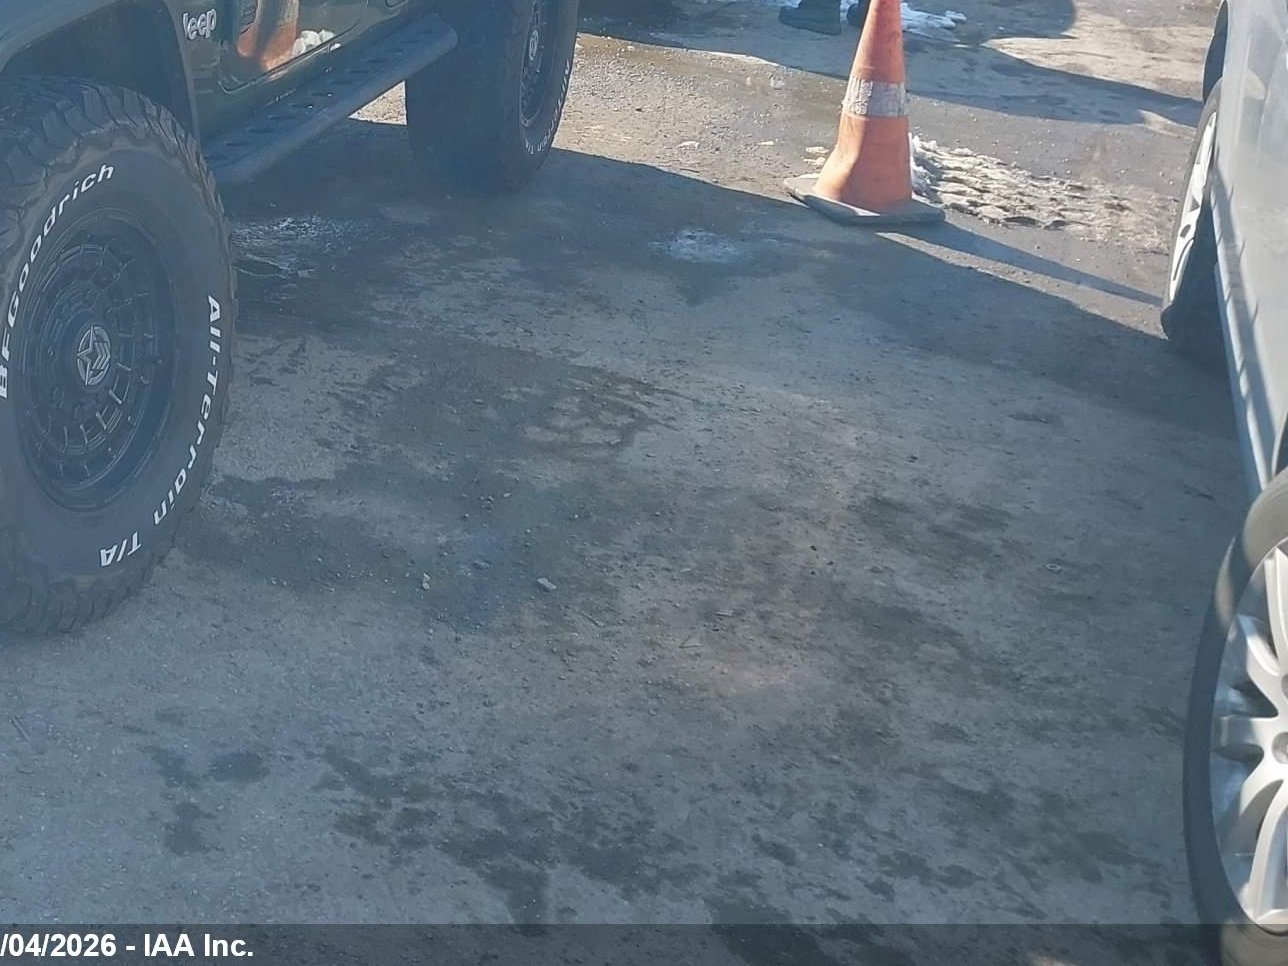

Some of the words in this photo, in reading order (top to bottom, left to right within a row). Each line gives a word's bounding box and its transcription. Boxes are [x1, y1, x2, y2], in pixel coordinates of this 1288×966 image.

[183, 8, 217, 40] Jeep
[153, 295, 222, 525] All-Terrain
[99, 531, 142, 567] T/A
